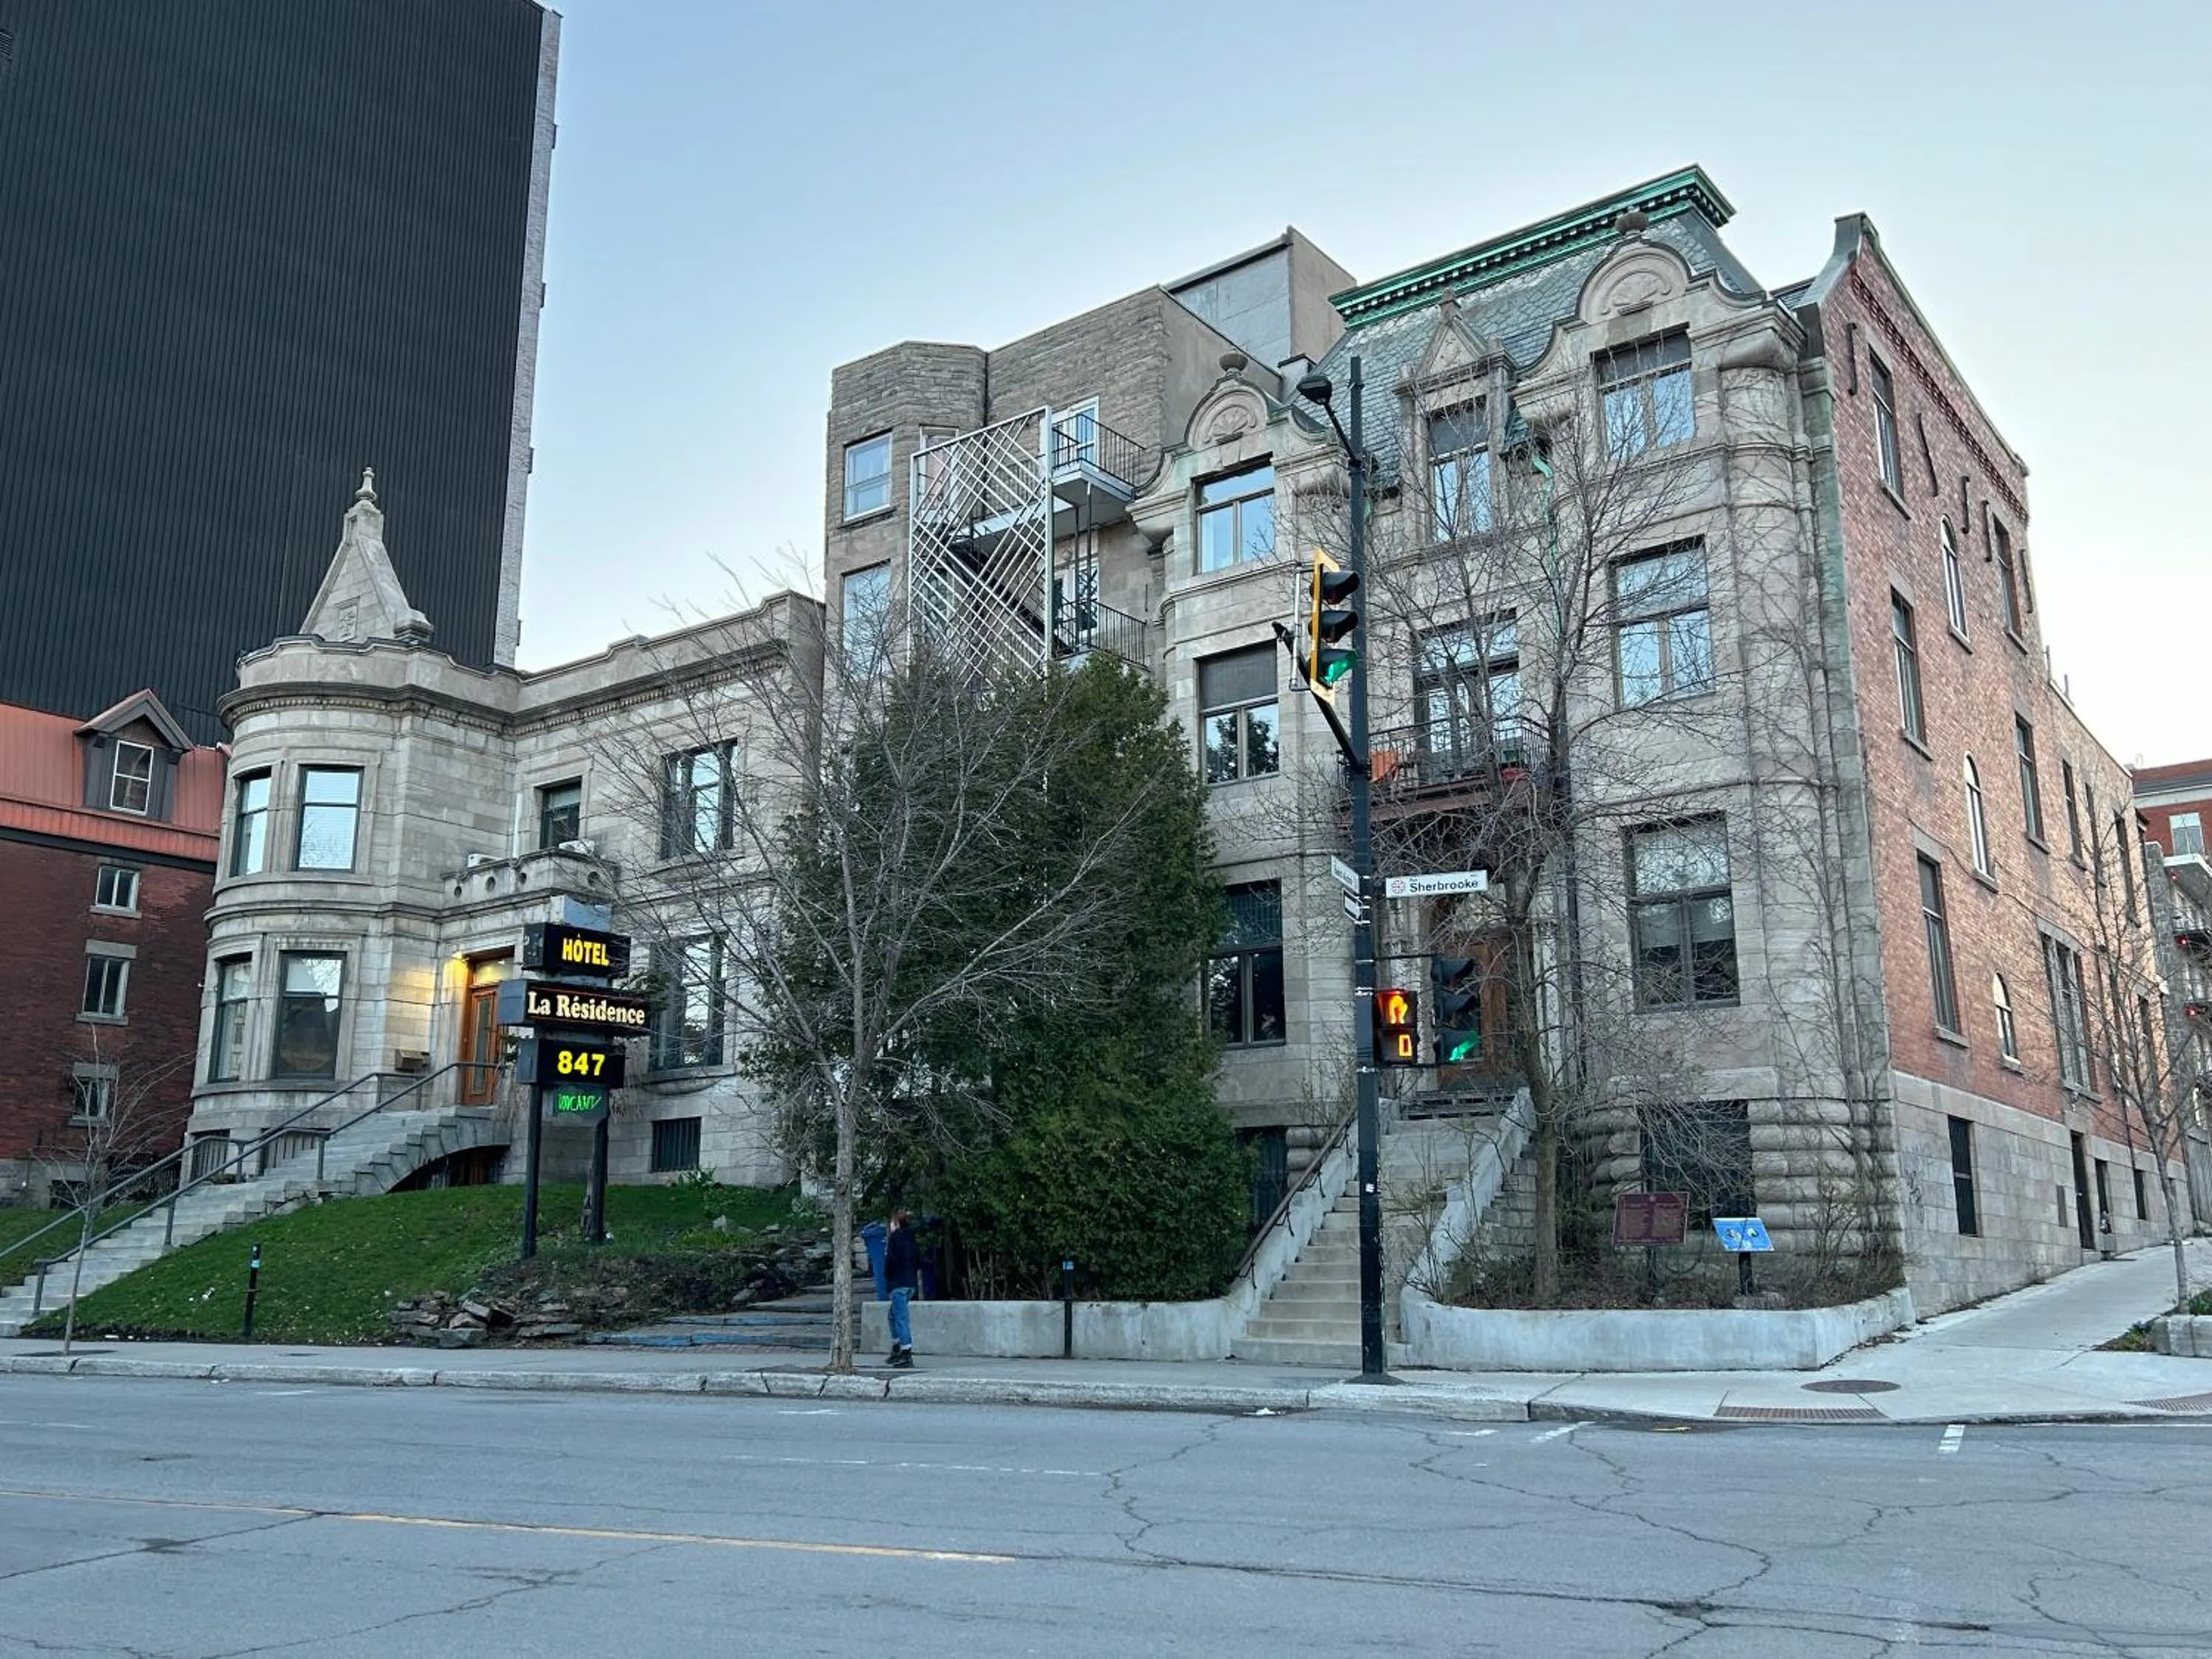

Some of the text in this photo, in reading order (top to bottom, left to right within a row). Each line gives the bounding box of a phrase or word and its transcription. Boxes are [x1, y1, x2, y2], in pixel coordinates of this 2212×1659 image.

[1409, 879, 1478, 893] Sherbrooke
[562, 933, 610, 966] HÔTEL
[528, 991, 645, 1025] La Résidence
[557, 1050, 605, 1076] 847
